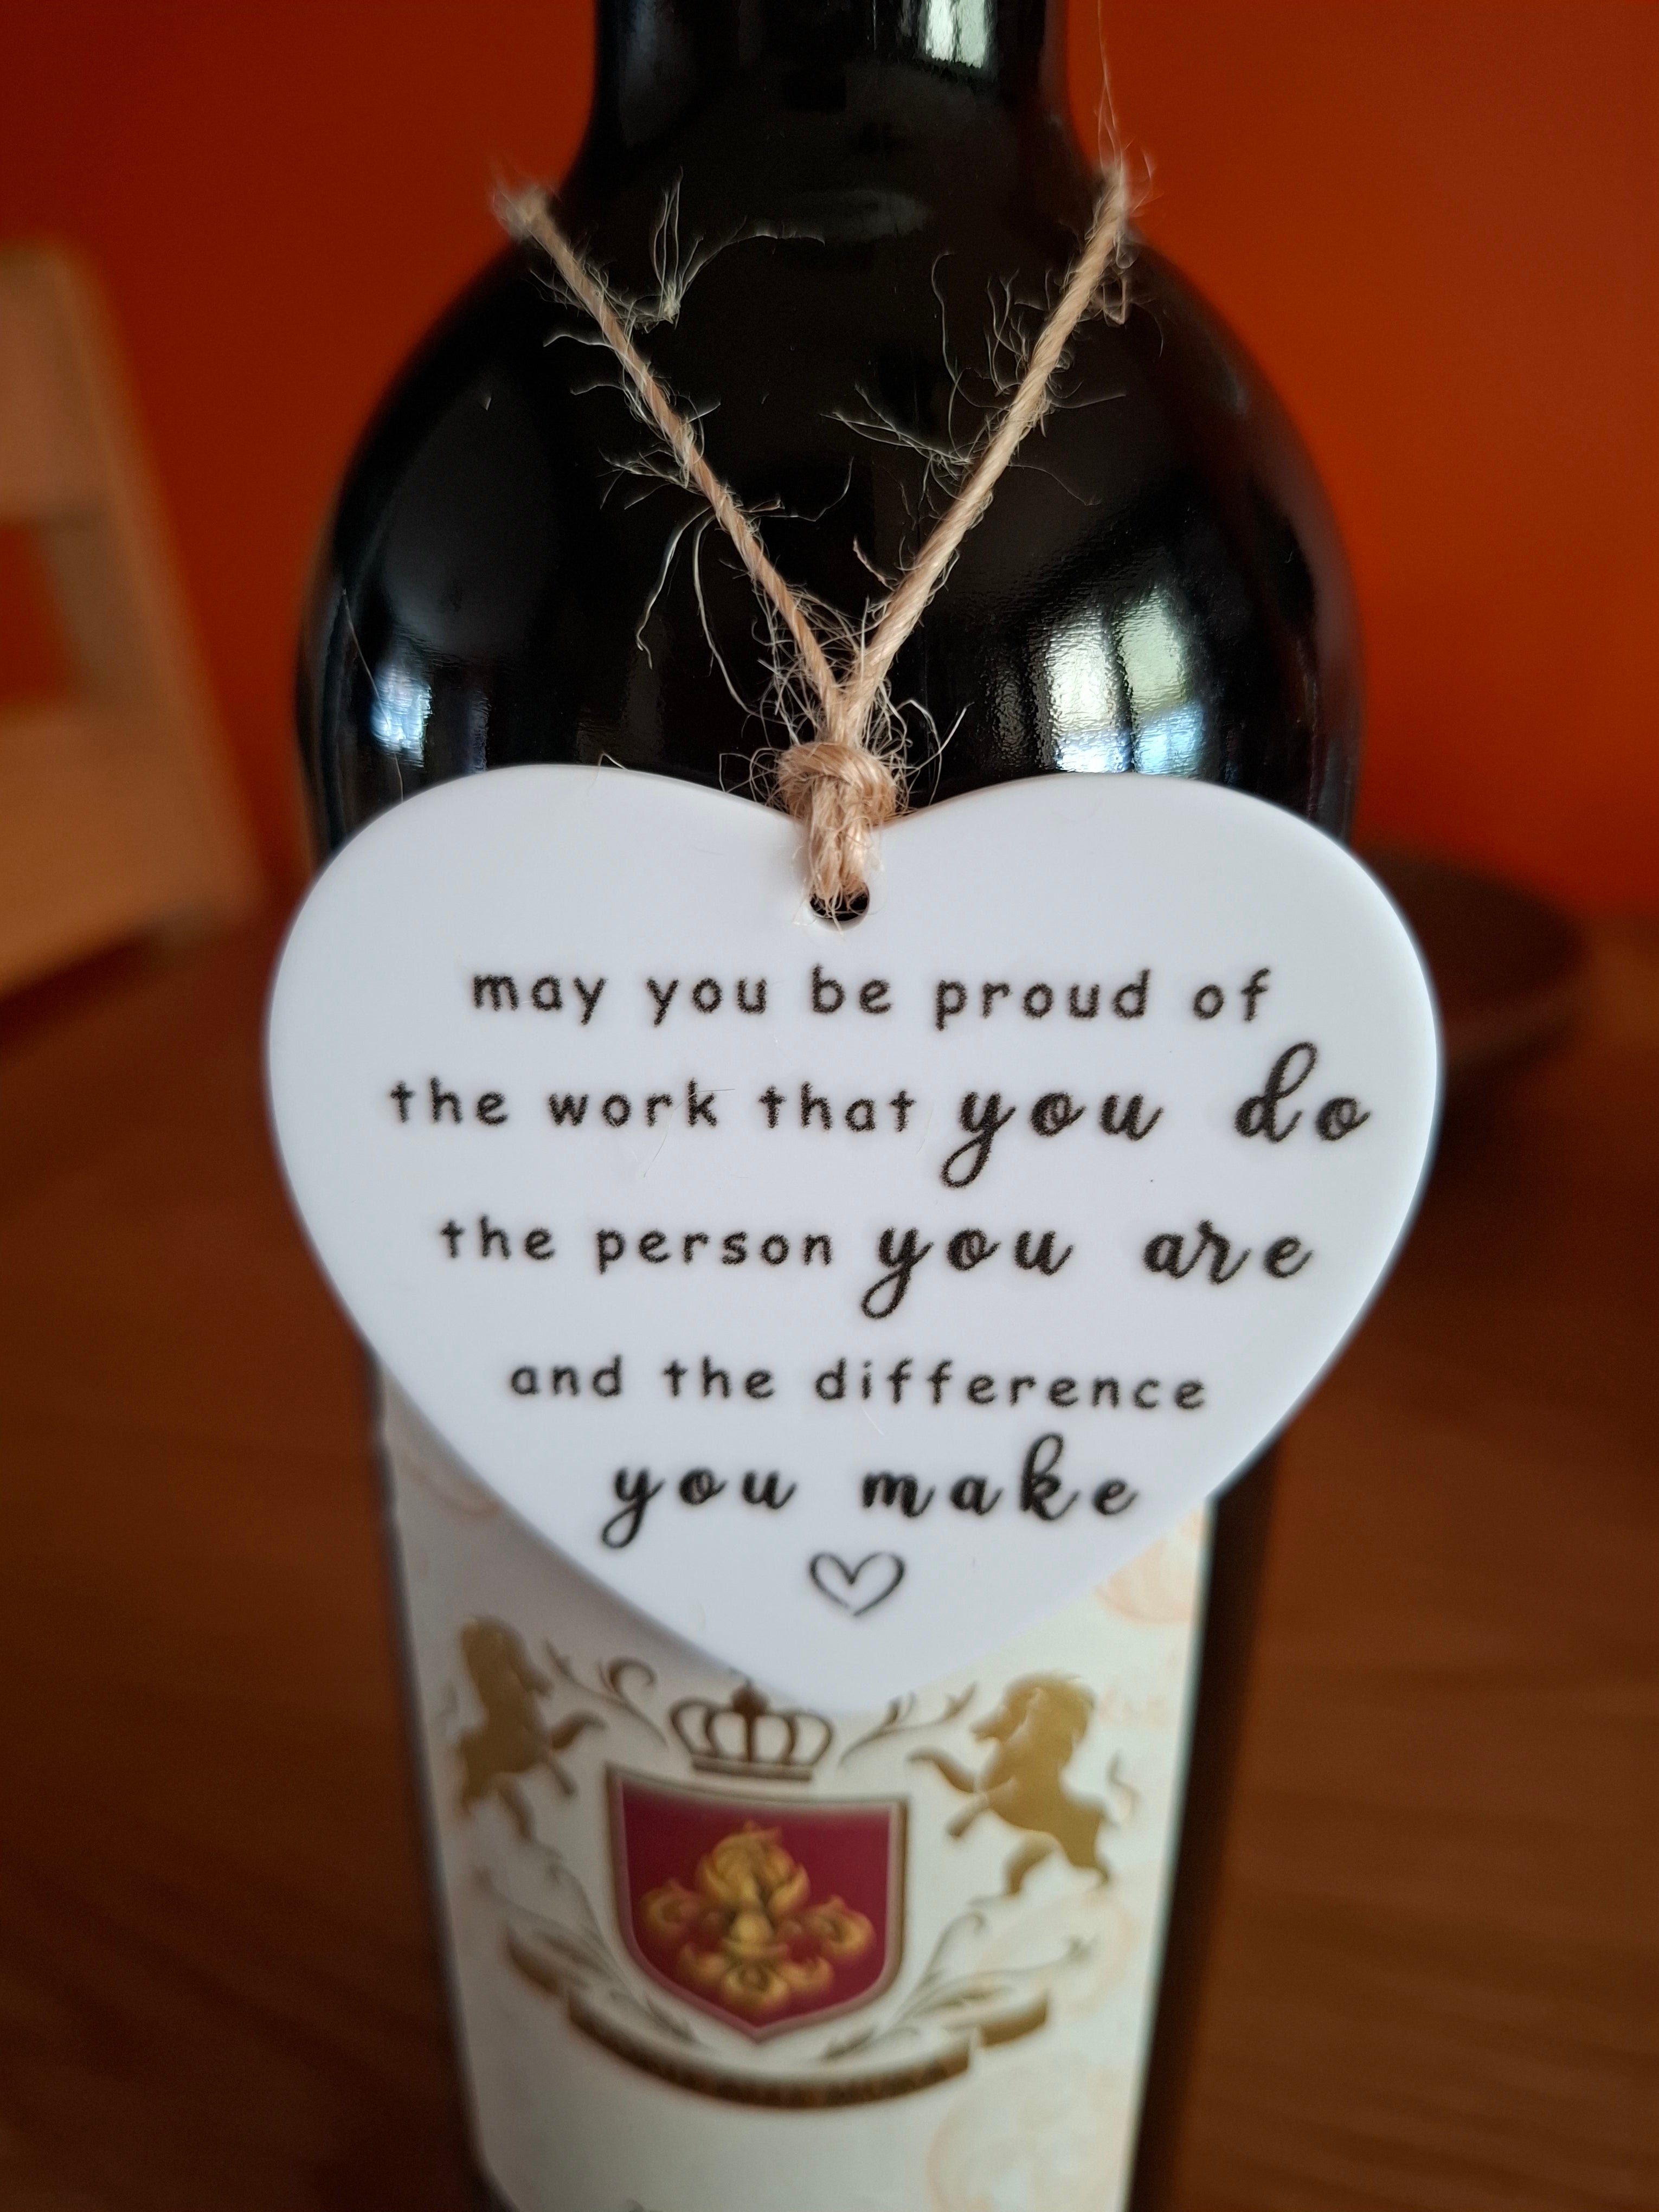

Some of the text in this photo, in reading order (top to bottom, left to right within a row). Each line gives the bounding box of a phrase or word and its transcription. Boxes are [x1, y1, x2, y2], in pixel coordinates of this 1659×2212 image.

[472, 964, 1271, 1031] may you be proud of
[390, 1041, 1371, 1188] the work that you do
[440, 1216, 1313, 1320] the person you are
[510, 1355, 1208, 1410] and the difference
[601, 1433, 1137, 1549] you make
